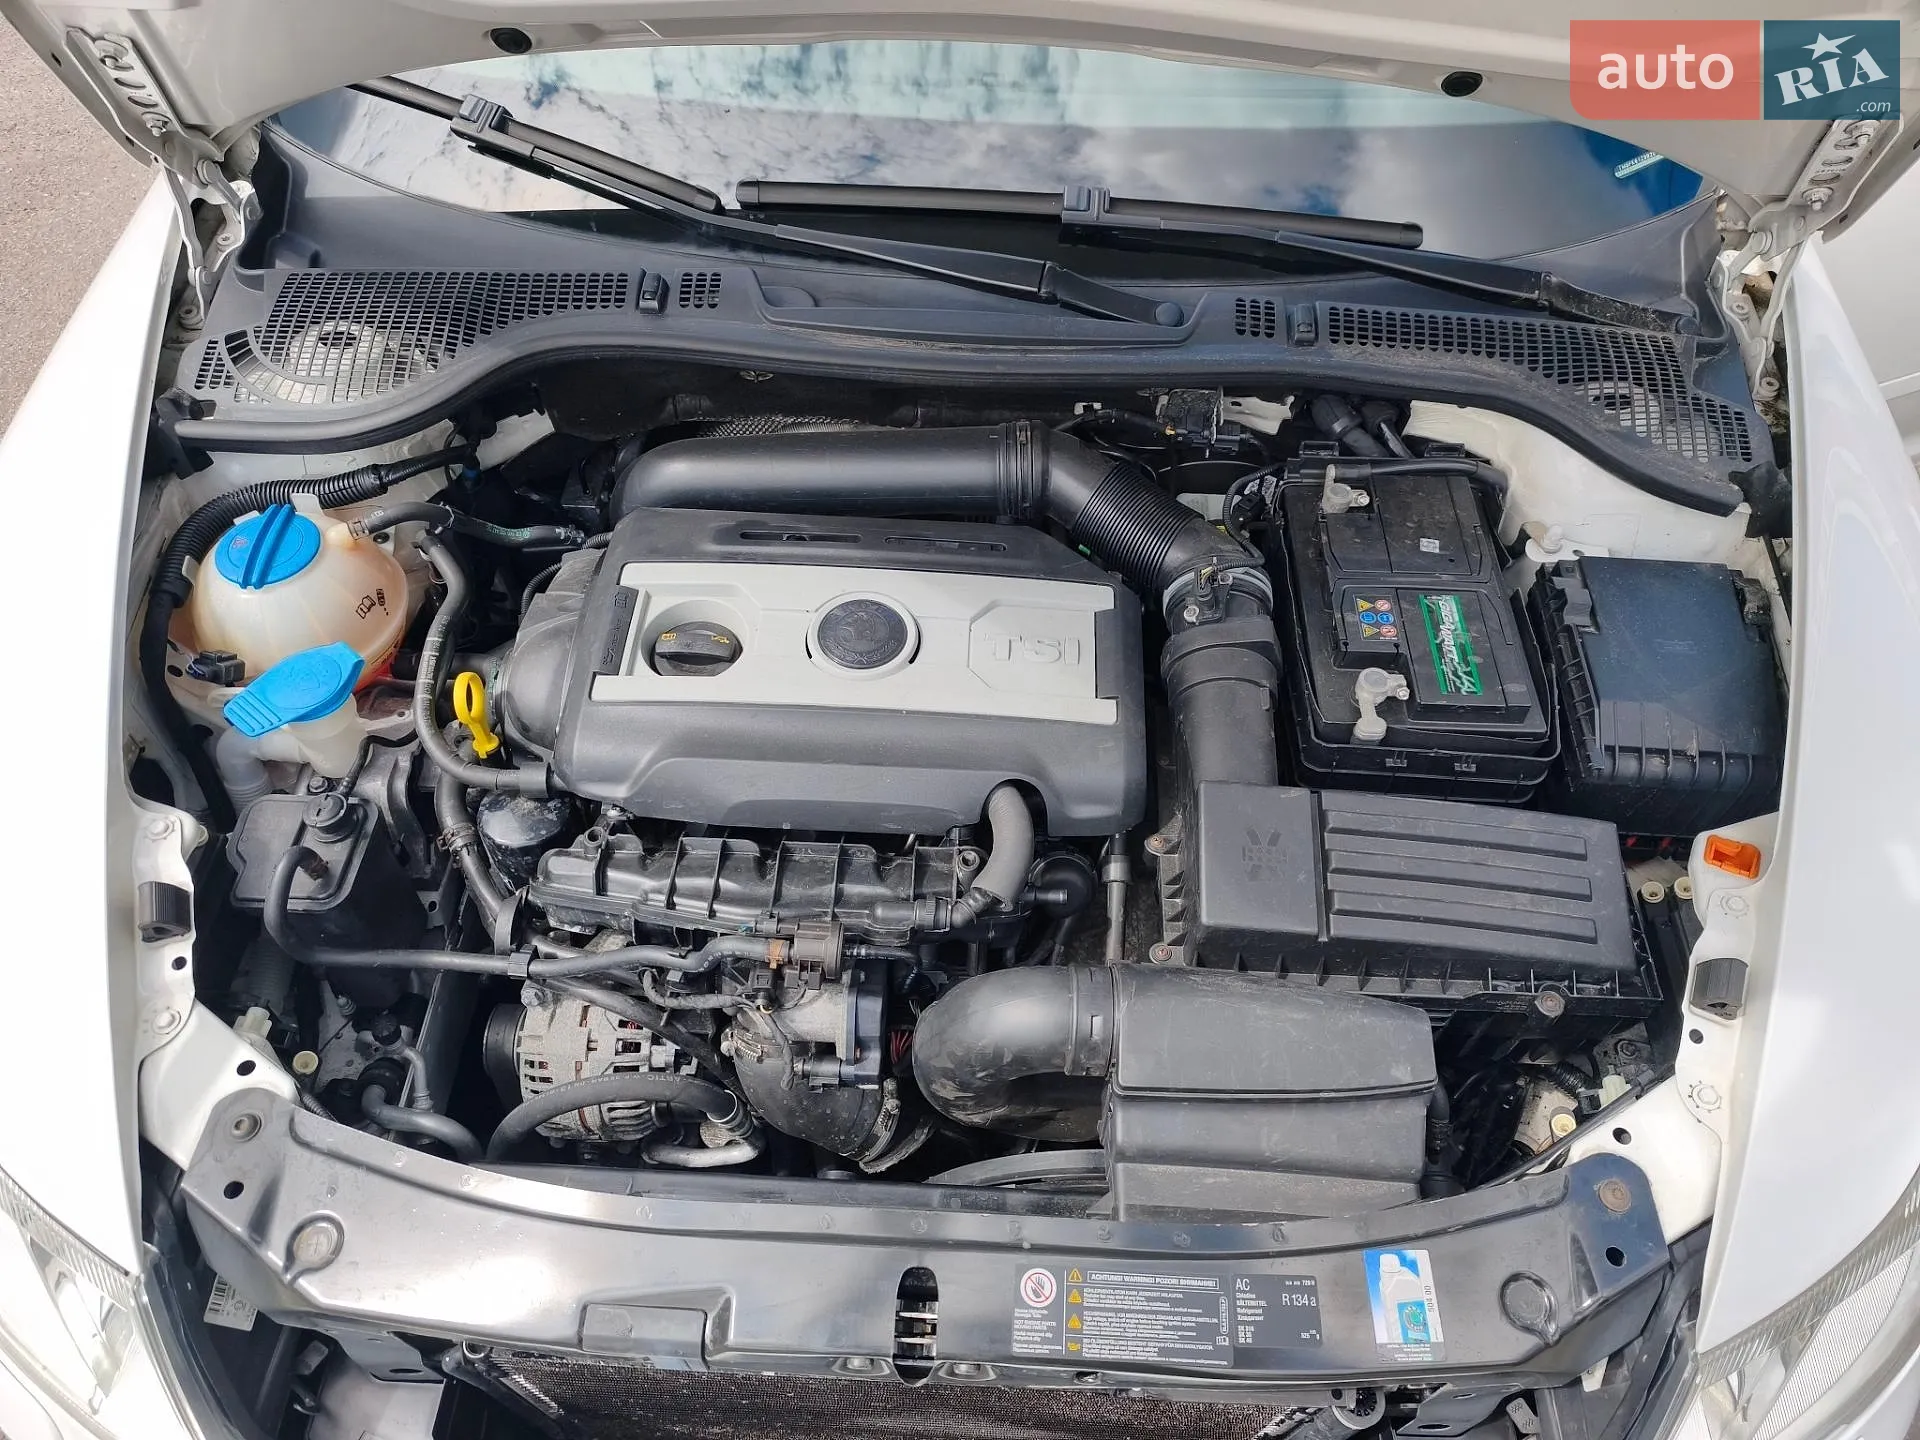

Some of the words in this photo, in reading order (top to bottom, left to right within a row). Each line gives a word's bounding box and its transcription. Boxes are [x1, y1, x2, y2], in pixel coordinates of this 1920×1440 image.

[984, 633, 1081, 665] TSI
[1236, 1279, 1250, 1290] AC
[1282, 1294, 1290, 1305] R
[1291, 1294, 1308, 1306] 134
[1310, 1297, 1317, 1306] a
